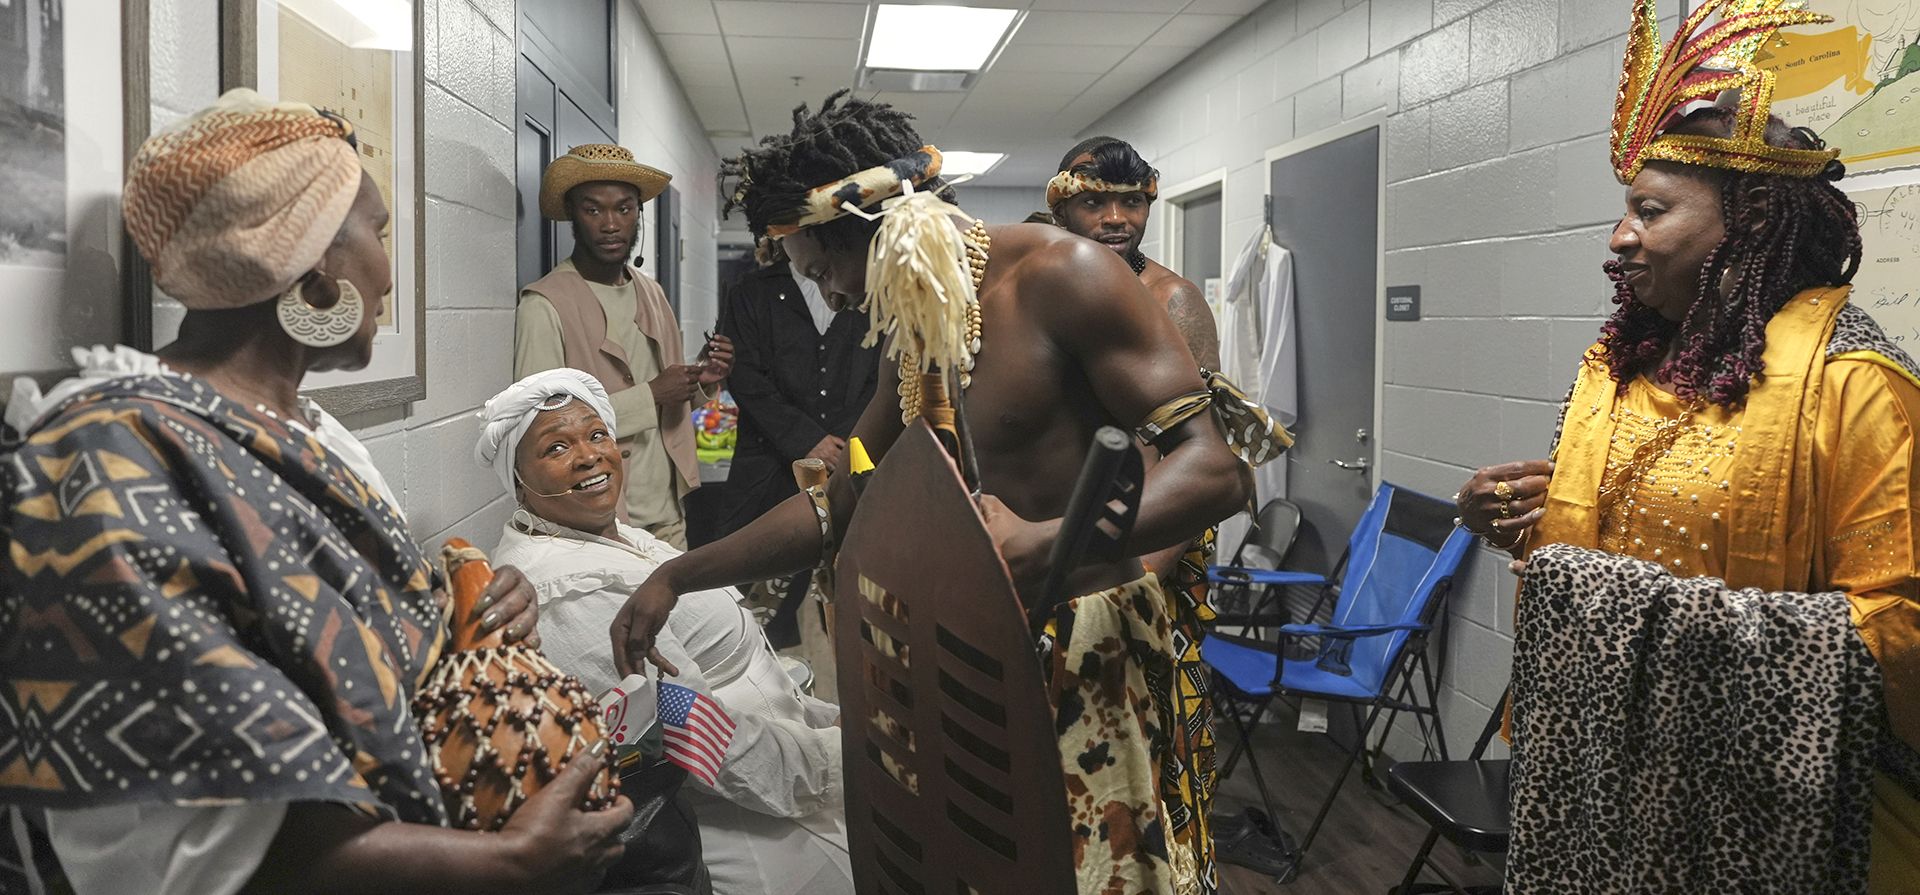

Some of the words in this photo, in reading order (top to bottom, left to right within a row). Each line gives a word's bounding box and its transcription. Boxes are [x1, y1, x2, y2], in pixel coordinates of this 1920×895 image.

[1785, 58, 1806, 69] South
[1809, 50, 1841, 62] Carolina
[1795, 95, 1837, 116] beautiful
[1808, 112, 1831, 127] place
[1393, 304, 1410, 312] CLOSET
